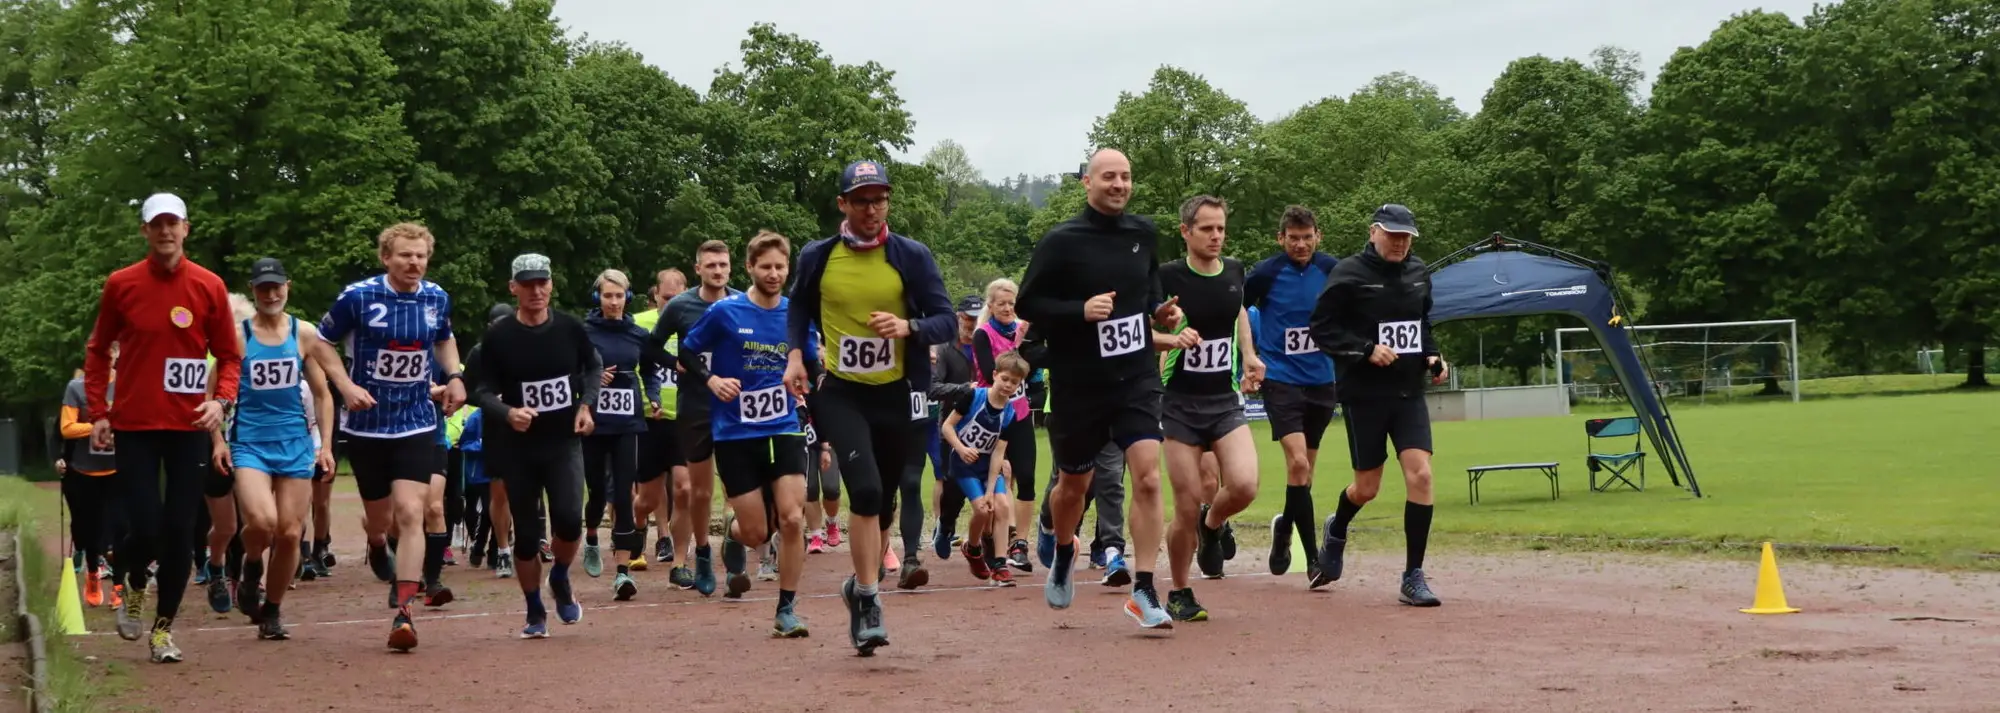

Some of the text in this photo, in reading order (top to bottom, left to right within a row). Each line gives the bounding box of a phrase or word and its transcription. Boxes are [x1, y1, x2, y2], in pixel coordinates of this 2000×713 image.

[368, 303, 388, 328] 2
[743, 340, 775, 353] Allianz
[1101, 318, 1142, 352] 354
[1288, 330, 1316, 351] 37
[1381, 324, 1419, 350] 362
[378, 353, 423, 379] 328
[842, 338, 892, 369] 364
[1187, 342, 1229, 369] 312
[168, 362, 206, 389] 302
[253, 361, 294, 387] 357
[525, 381, 569, 409] 363
[600, 391, 632, 412] 338
[743, 388, 785, 419] 326
[966, 425, 997, 451] 350
